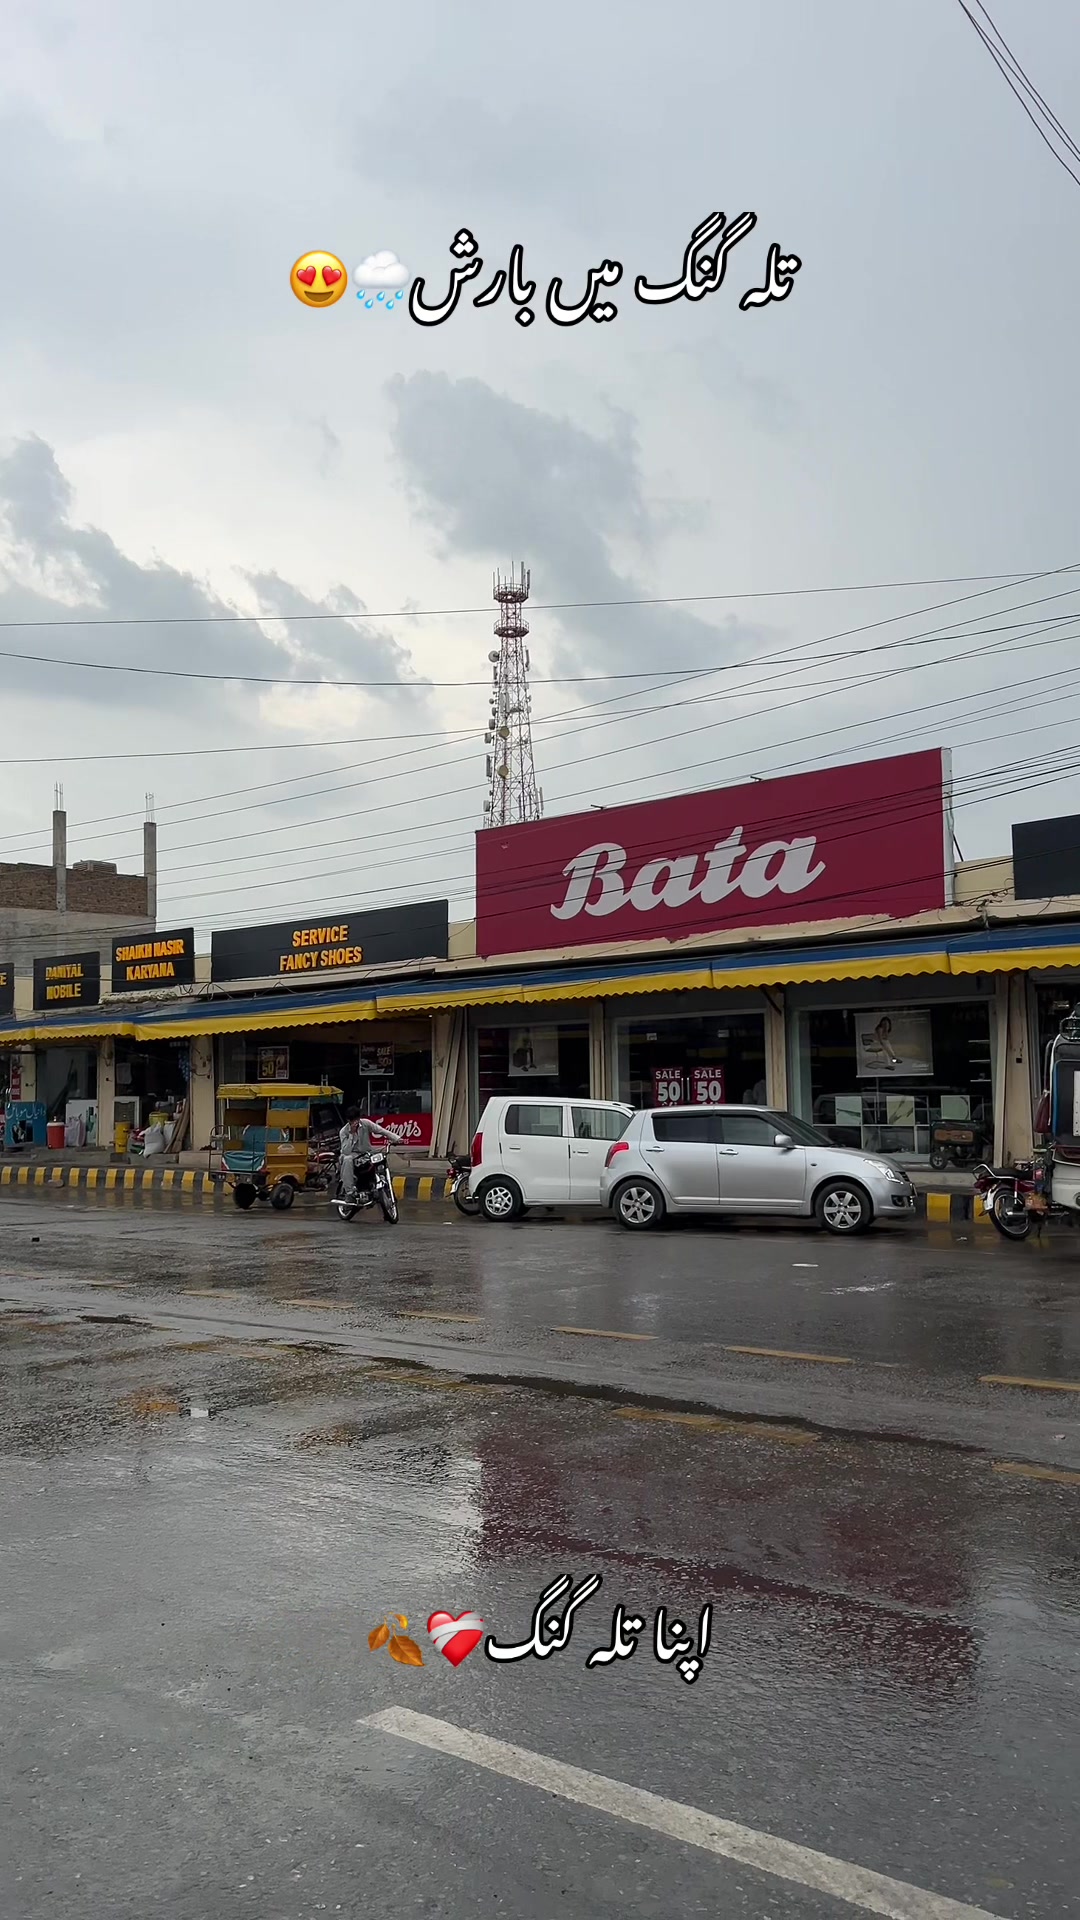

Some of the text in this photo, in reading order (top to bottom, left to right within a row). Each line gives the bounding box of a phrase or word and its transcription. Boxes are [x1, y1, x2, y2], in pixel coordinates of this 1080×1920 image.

[550, 826, 826, 920] Bata
[292, 925, 349, 947] SERVICE
[115, 939, 184, 962] SHAIKH NASIR
[279, 946, 362, 971] FANCY SHOES
[126, 961, 175, 981] KARYANA
[46, 983, 82, 1000] MOBILE
[655, 1070, 681, 1079] SALE
[694, 1069, 722, 1079] SALE
[657, 1081, 681, 1102] 50
[696, 1080, 722, 1102] 50
